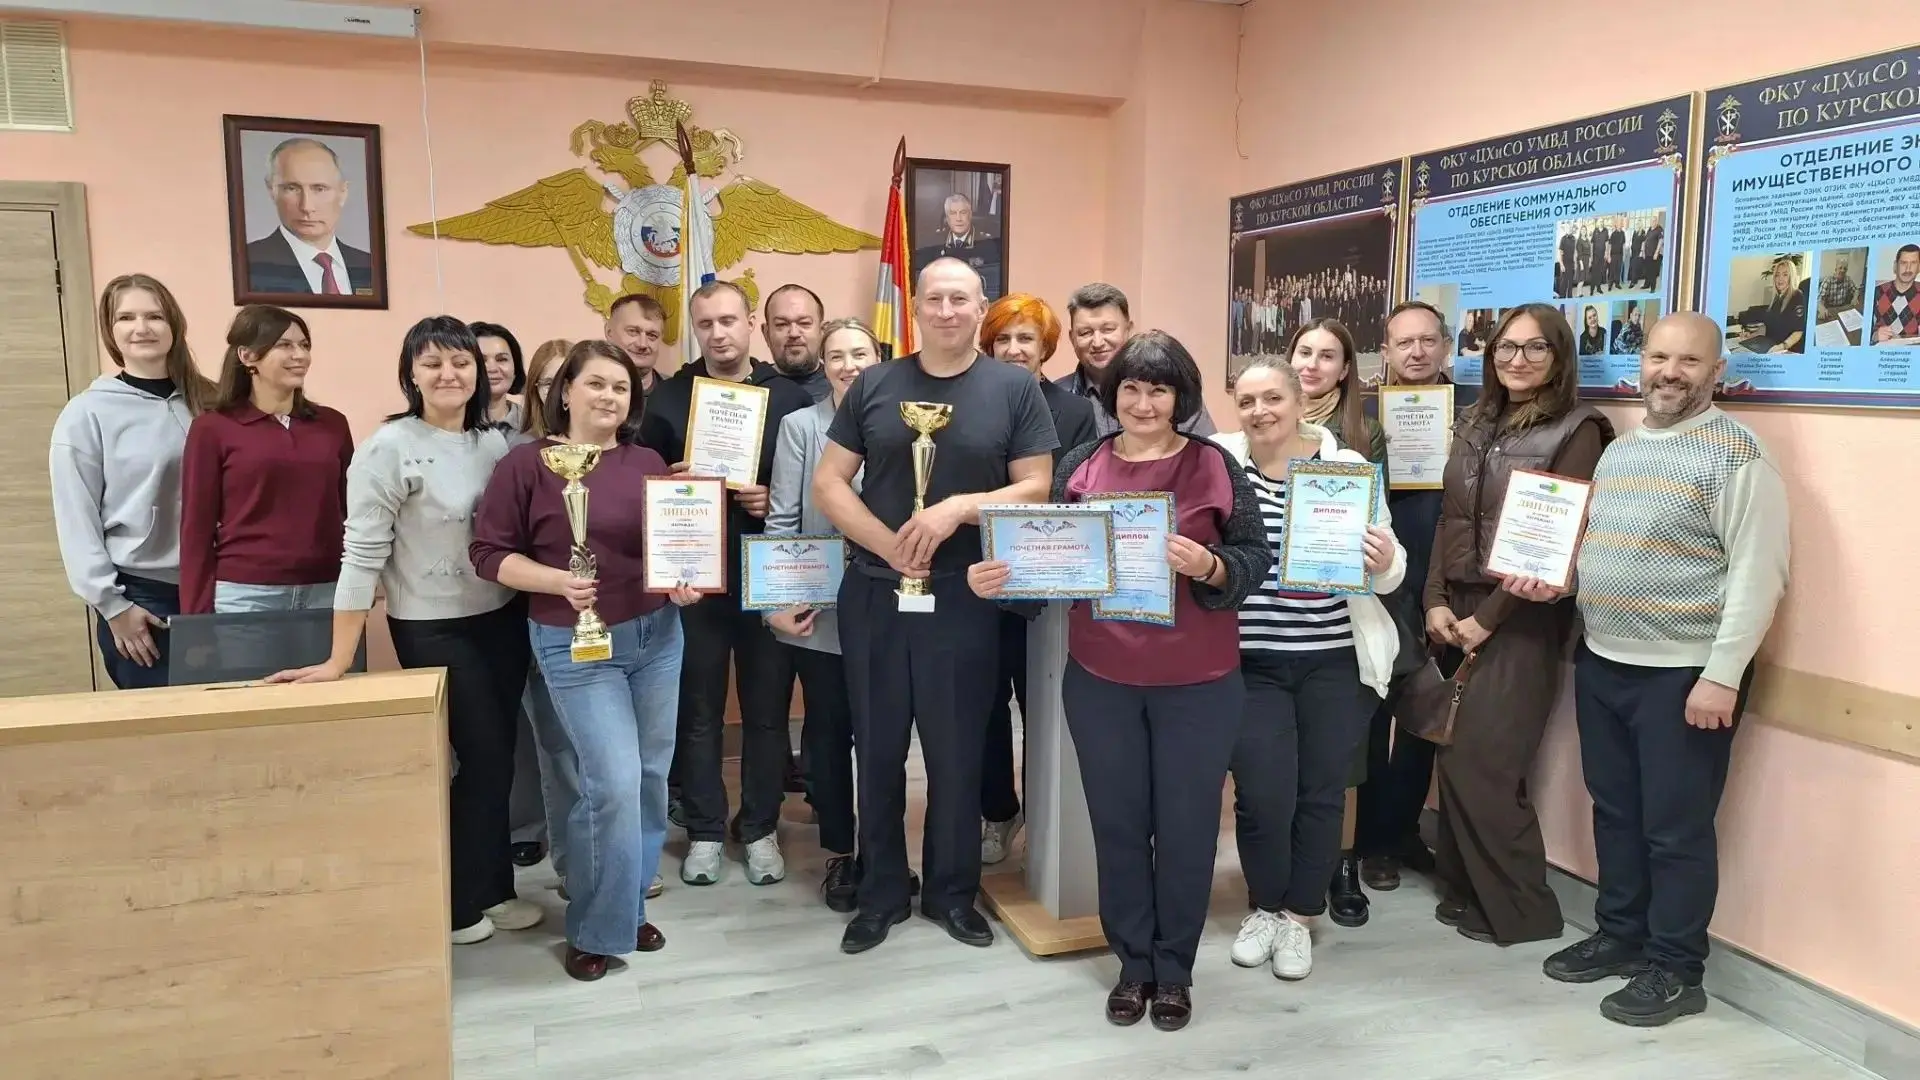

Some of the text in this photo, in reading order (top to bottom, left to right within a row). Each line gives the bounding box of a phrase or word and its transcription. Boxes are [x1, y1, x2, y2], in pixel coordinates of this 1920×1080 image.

[1759, 59, 1909, 106] ФКУ «ЦХиСО
[1777, 106, 1809, 130] ПО
[1440, 114, 1645, 171] ФКУ «ЦХиСО УМВД РОССИИ
[1780, 138, 1894, 168] ОТДЕЛЕНИЕ
[1451, 142, 1626, 189] ПО КУРСКОЙ ОБЛАСТИ»
[1731, 156, 1912, 192] ИМУЩЕСТВЕННОГО
[1249, 198, 1266, 211] ФКУ
[1304, 183, 1330, 199] УМВД
[1333, 172, 1376, 193] РОССИИ
[1448, 180, 1627, 218] ОТДЕЛЕНИЕ КОММУНАЛЬНОГО
[1256, 194, 1364, 226] ПО КУРСКОЙ ОБЛАСТИ»
[1469, 200, 1596, 229] ОБЕСПЕЧЕНИЯ ОТЭИК
[711, 415, 744, 426] ГРАМОТА
[660, 507, 708, 517] ДИПЛОМ
[1313, 507, 1348, 515] ДИПЛОМ
[1516, 498, 1569, 516] ДИПЛОМ
[1052, 544, 1091, 552] ГРАМОТА
[1115, 533, 1149, 541] ДИПЛОМ
[799, 563, 830, 571] ГРАМОТА
